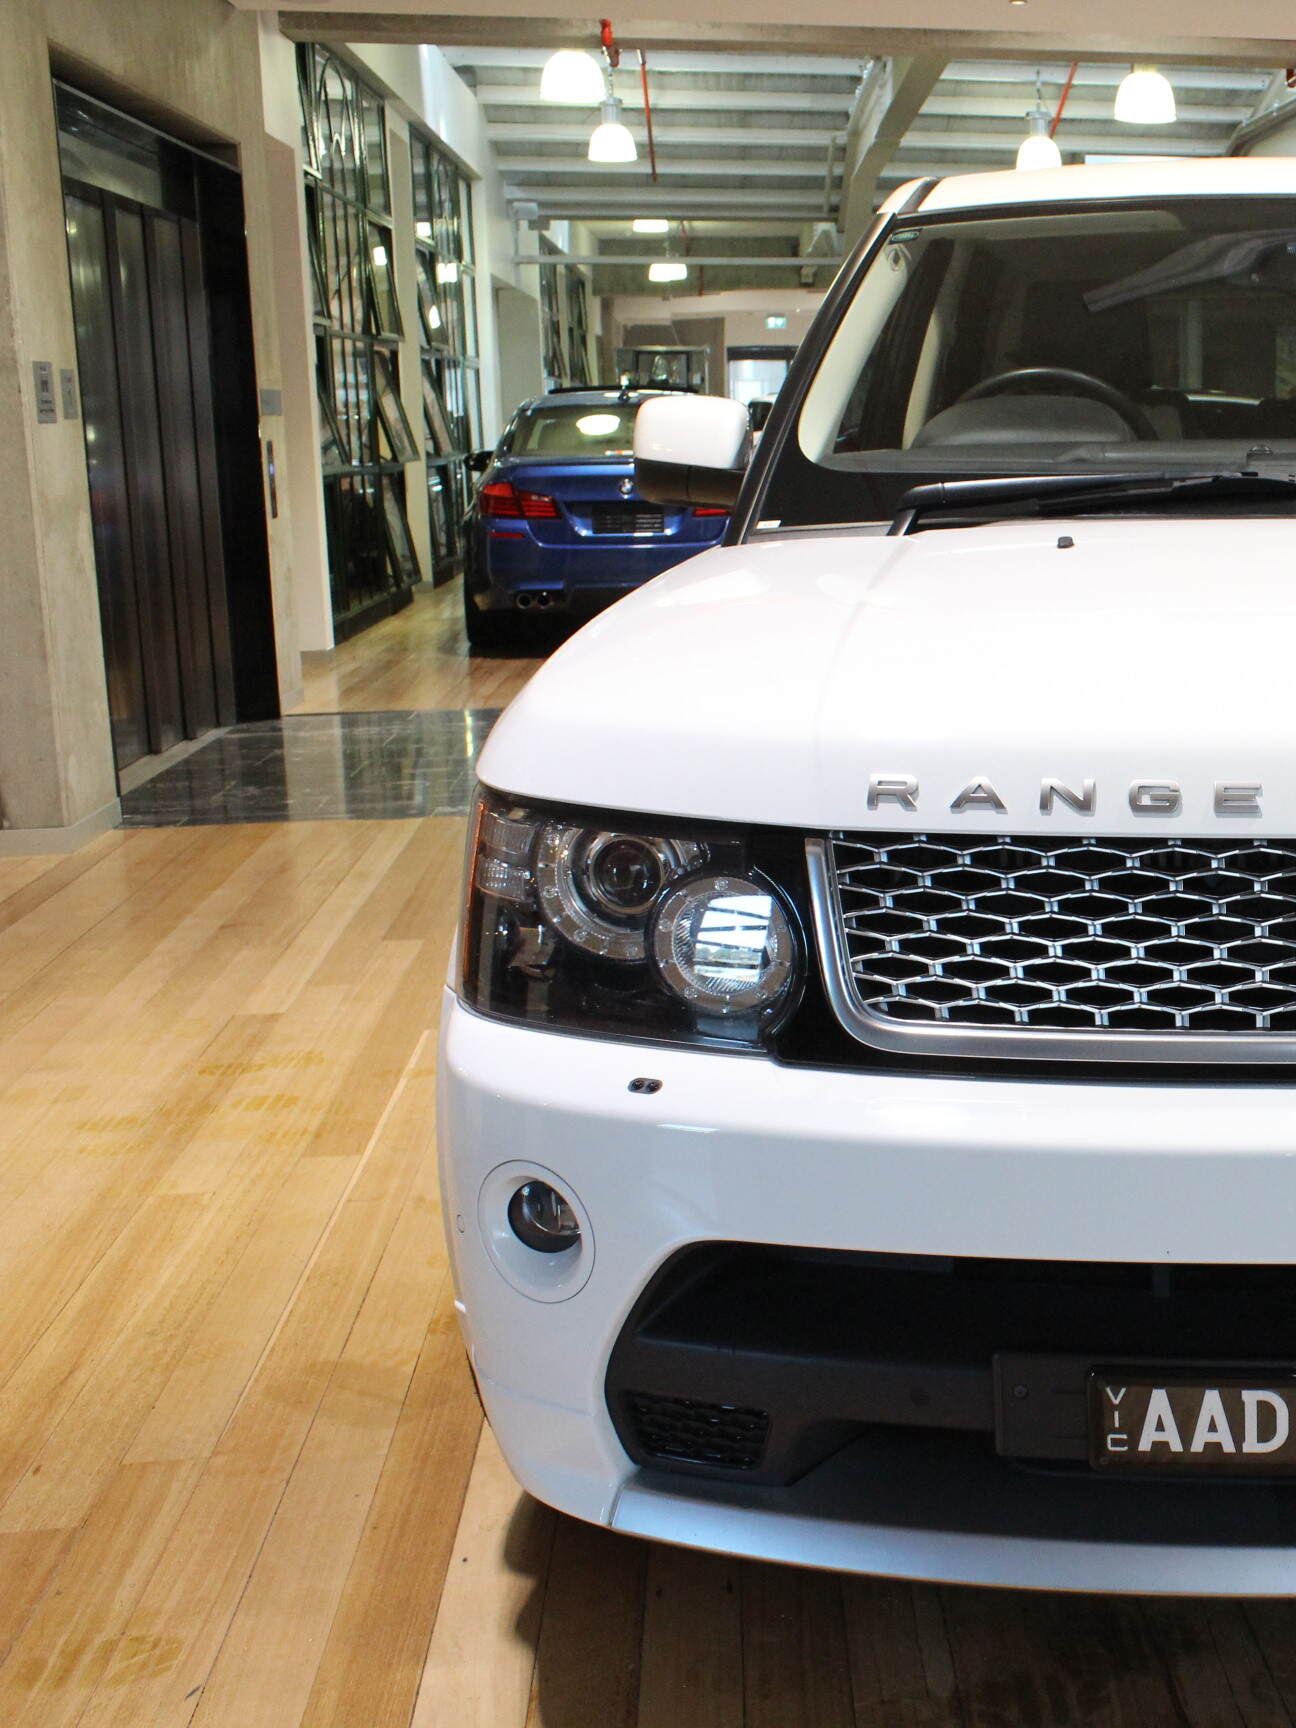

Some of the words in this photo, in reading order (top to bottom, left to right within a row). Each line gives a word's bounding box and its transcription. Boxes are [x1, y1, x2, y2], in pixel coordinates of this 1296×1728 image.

[866, 772, 1263, 817] RANGE
[1105, 1386, 1129, 1452] VIC
[1137, 1387, 1290, 1454] AAD
